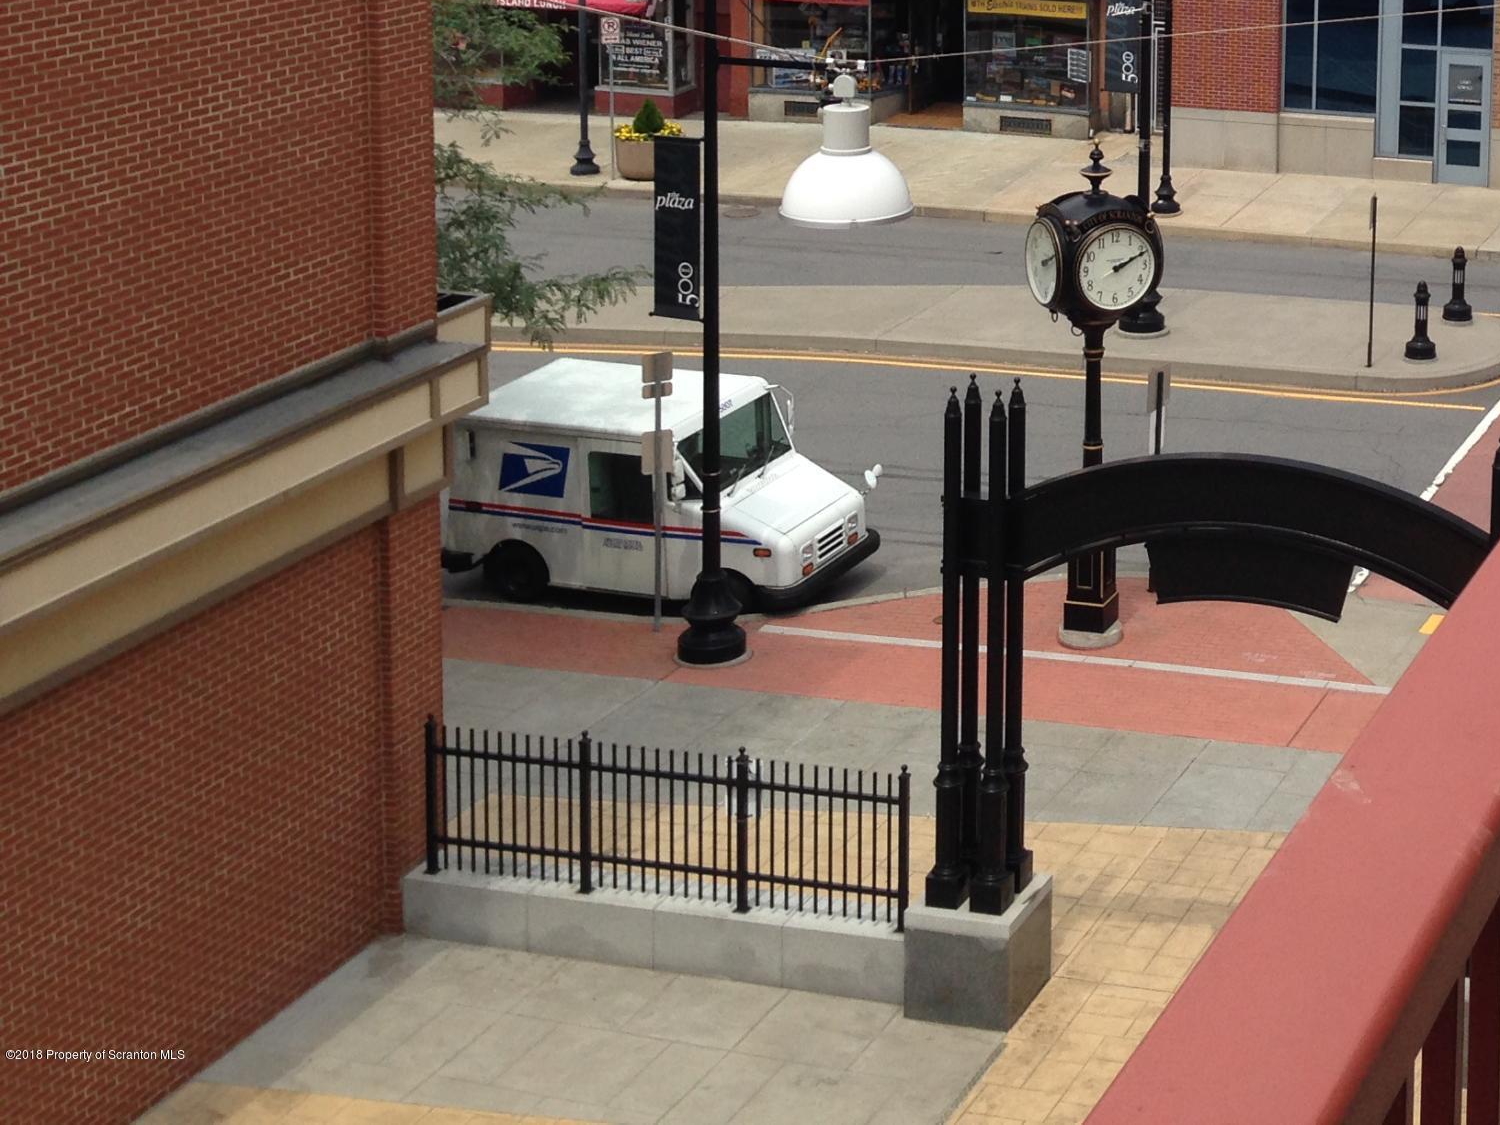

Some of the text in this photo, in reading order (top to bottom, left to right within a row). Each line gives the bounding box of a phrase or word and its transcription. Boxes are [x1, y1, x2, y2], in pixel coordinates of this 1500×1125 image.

[533, 0, 567, 10] LUNCH
[1121, 51, 1139, 84] 500
[655, 192, 695, 210] plaza
[1111, 231, 1121, 244] 12
[1127, 235, 1132, 246] 1
[1098, 238, 1105, 249] 11
[1085, 251, 1095, 262] 10
[1142, 260, 1148, 271] 3
[1083, 266, 1089, 277] 9
[1137, 274, 1143, 284] 4
[678, 262, 700, 308] 500
[1087, 280, 1093, 291] 8
[1097, 291, 1103, 302] 7
[1112, 292, 1118, 304] 6
[1127, 287, 1134, 298] 5
